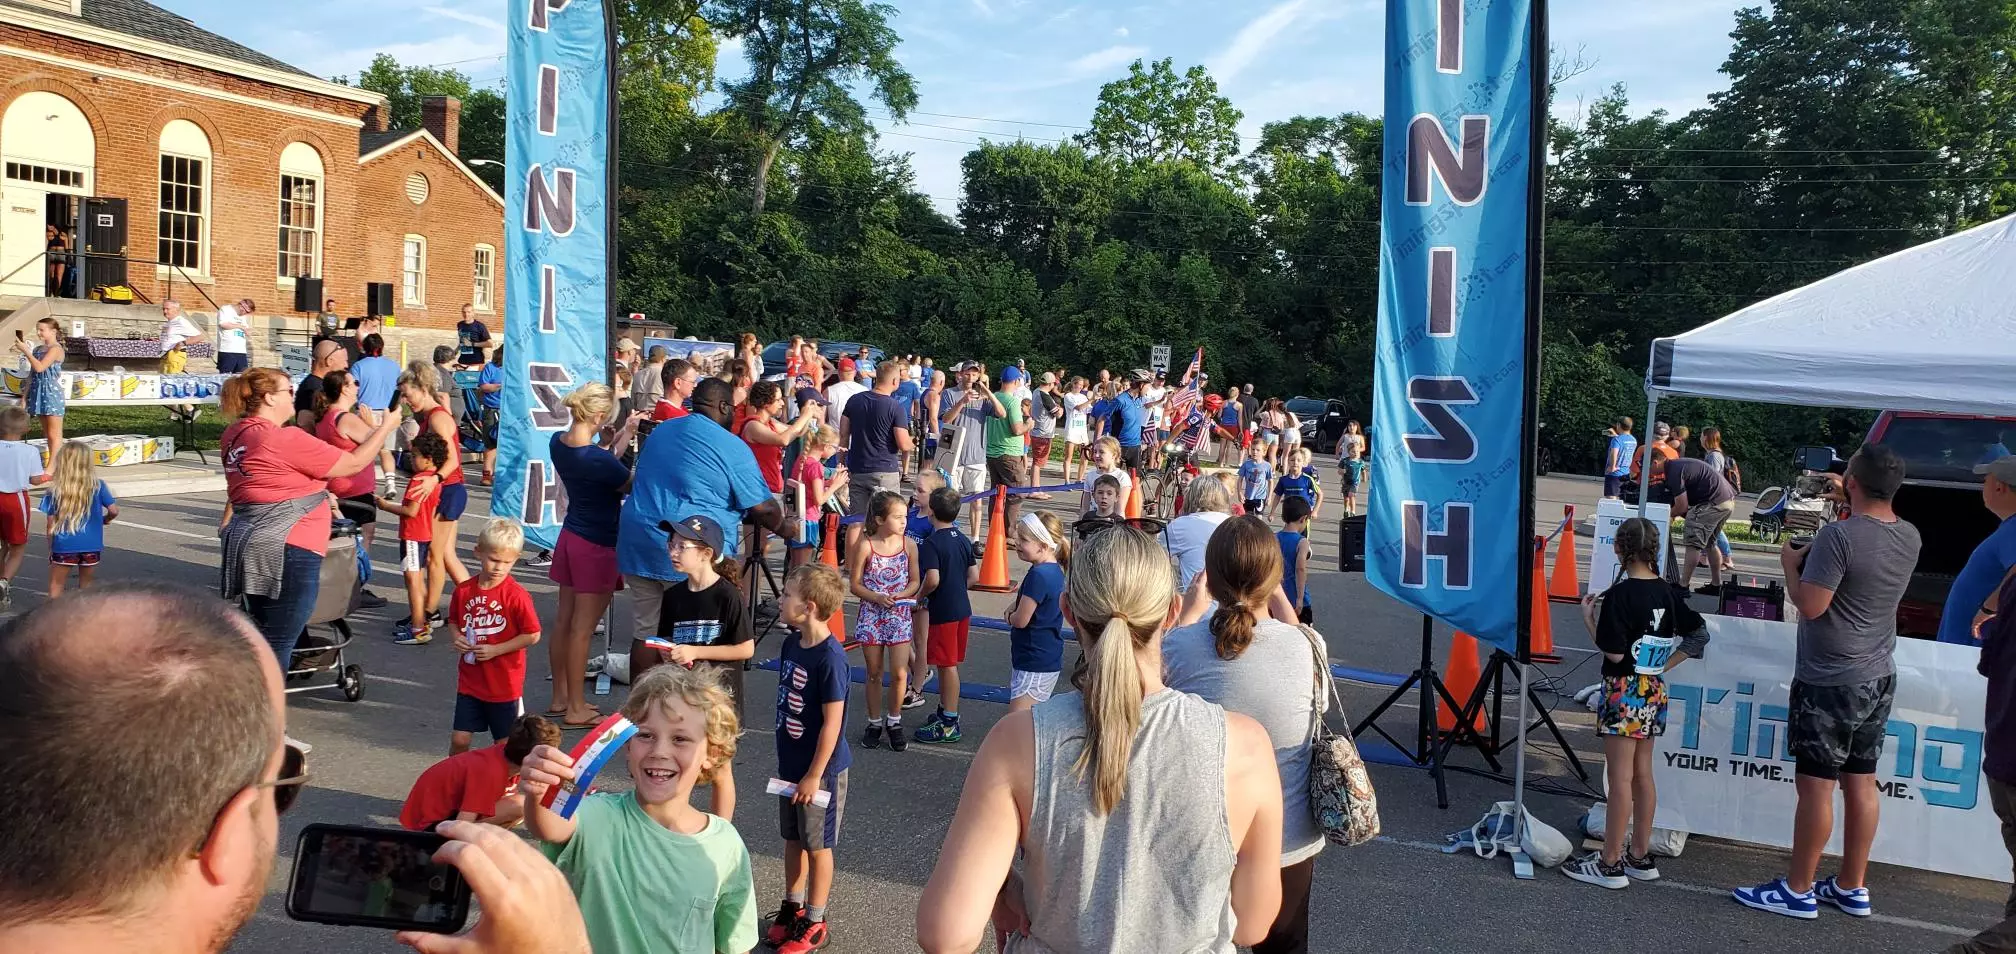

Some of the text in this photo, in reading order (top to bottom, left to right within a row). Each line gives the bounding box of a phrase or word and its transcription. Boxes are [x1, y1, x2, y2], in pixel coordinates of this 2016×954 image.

[465, 597, 503, 612] HOME OF
[476, 607, 488, 616] The
[461, 612, 506, 633] Brave
[1663, 751, 1719, 773] YOUR
